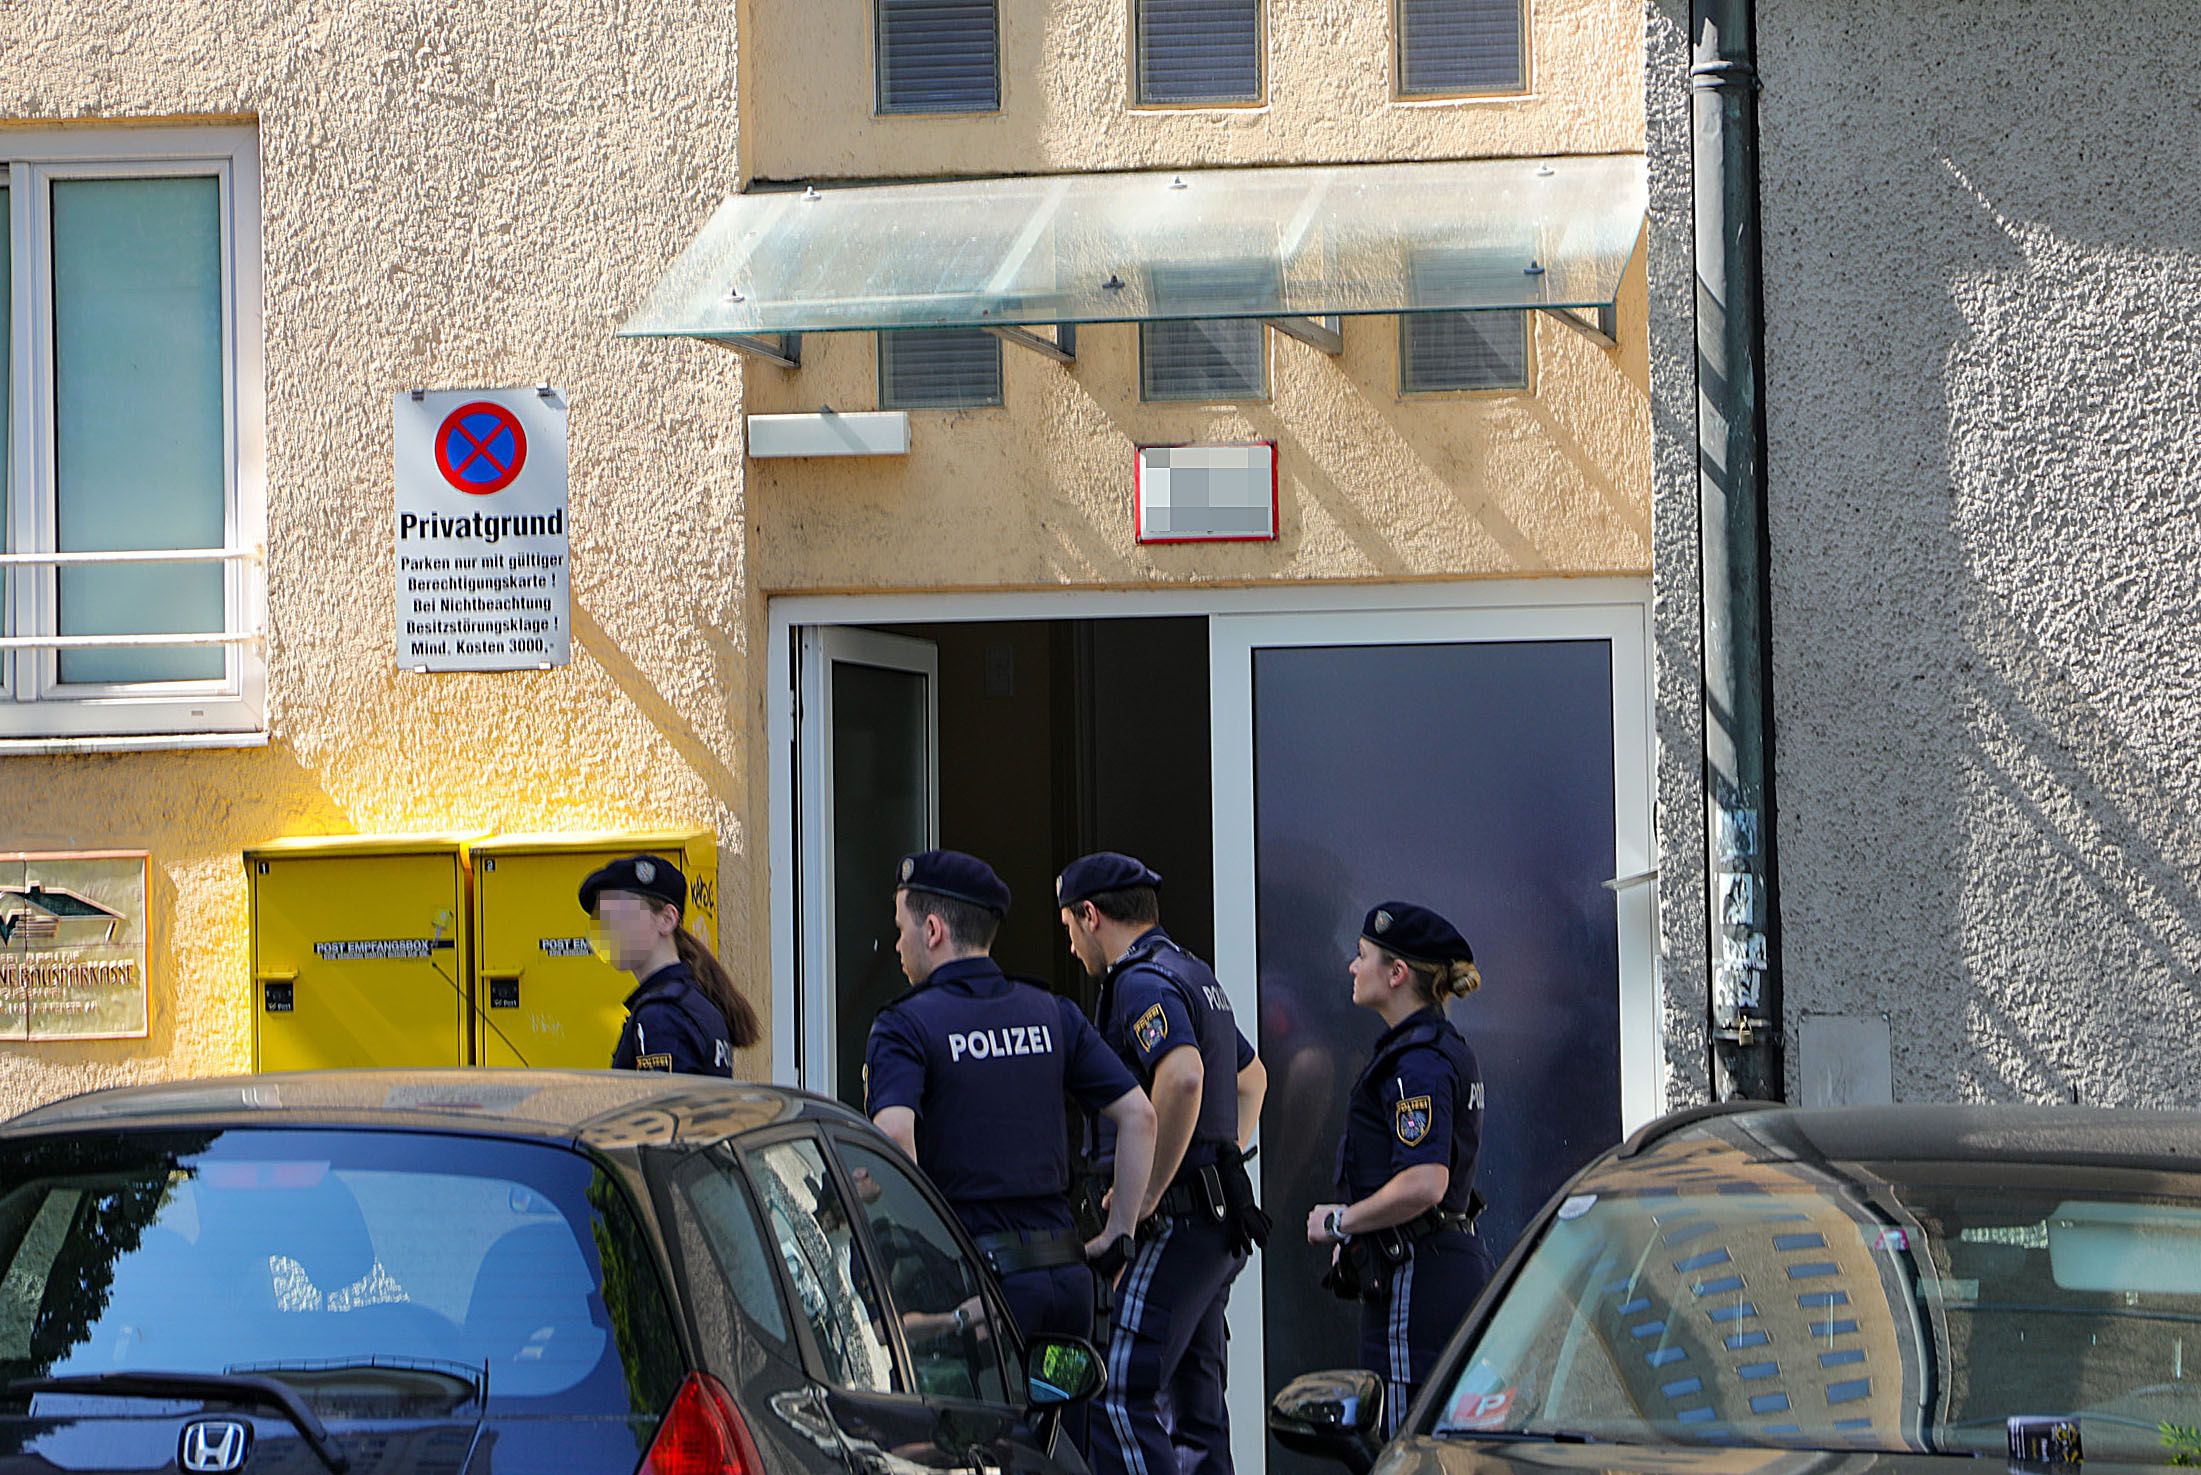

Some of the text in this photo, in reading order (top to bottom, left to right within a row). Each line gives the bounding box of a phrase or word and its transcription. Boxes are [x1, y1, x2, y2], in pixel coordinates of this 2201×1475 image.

[400, 507, 563, 543] Privatgrund
[401, 551, 564, 571] Parken nur mit gültiger
[407, 573, 547, 592] Berechtigungskarte
[413, 596, 552, 613] Bei Nichtbeachtung
[406, 617, 549, 635] Besitzstörungsklage
[411, 640, 451, 656] Mind.
[456, 638, 505, 655] Kosten
[316, 939, 430, 954] POST EMPFANGSBOX
[542, 939, 571, 950] POST
[949, 1025, 1053, 1062] POLIZEI
